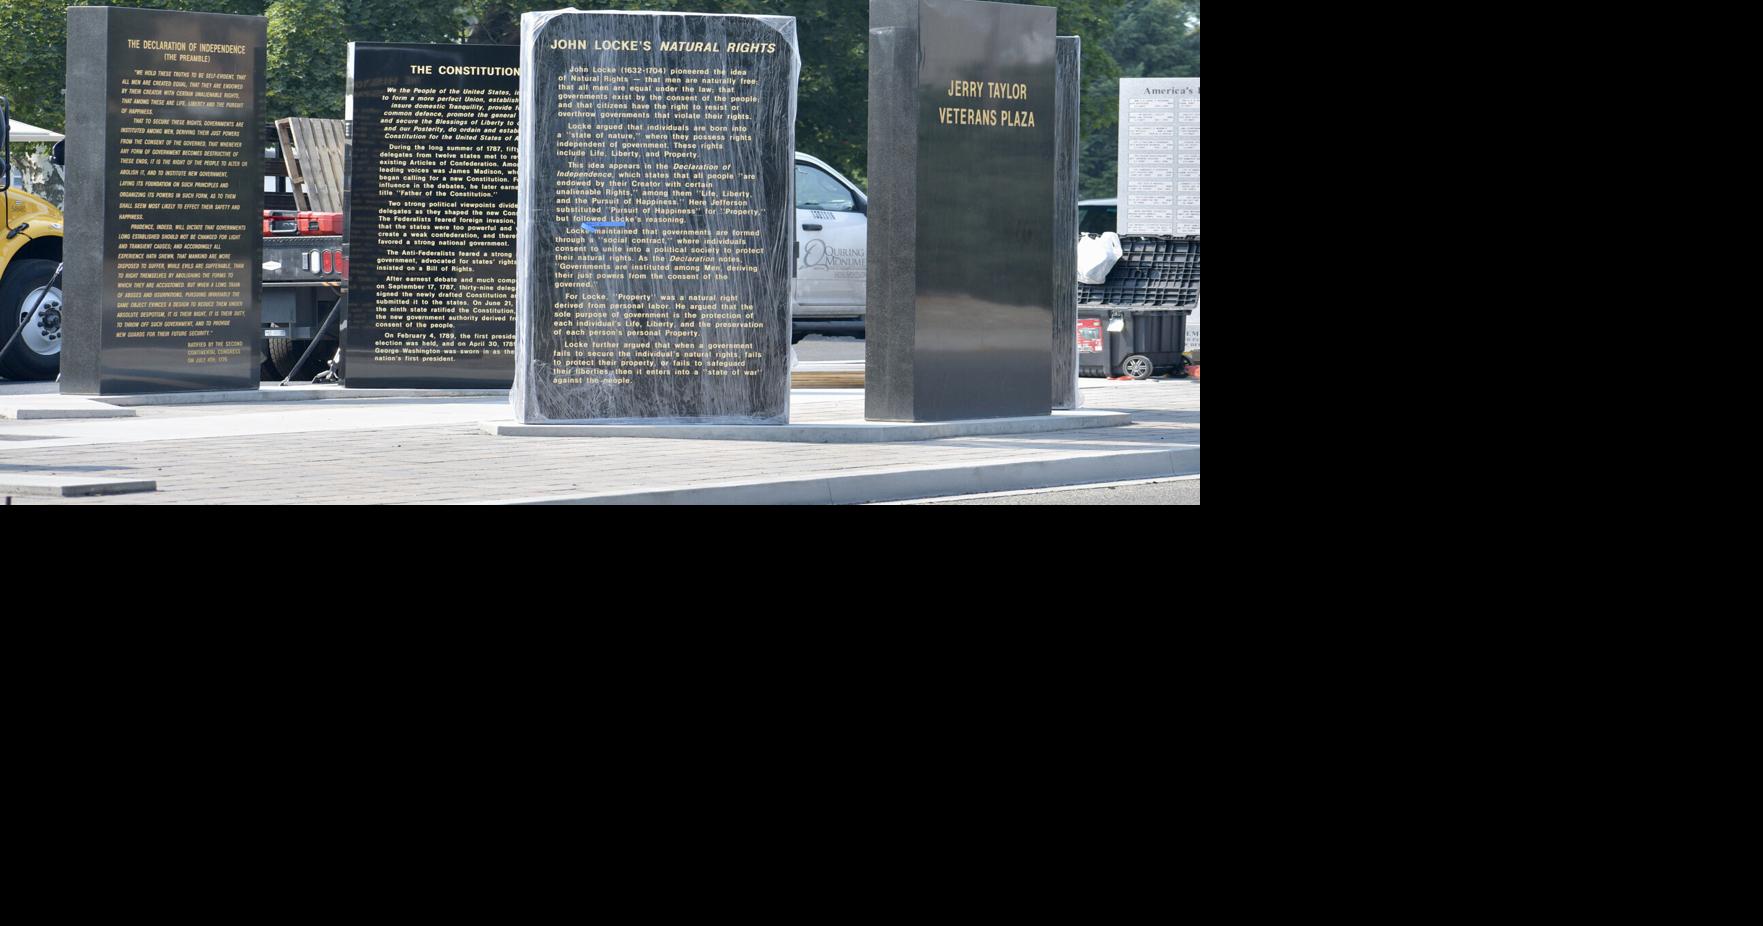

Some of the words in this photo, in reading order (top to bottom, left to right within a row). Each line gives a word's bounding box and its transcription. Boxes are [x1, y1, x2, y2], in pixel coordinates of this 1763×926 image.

[128, 39, 139, 49] THE
[143, 40, 185, 52] DECLARATION
[188, 42, 196, 52] OF
[199, 43, 245, 55] INDEPENDENCE
[551, 39, 586, 50] JOHN
[595, 40, 650, 52] LOCKE'S
[659, 41, 718, 53] NATURAL
[727, 42, 775, 54] RIGHTS
[164, 53, 176, 61] (THE
[179, 54, 210, 63] PREAMBLE)
[410, 65, 431, 74] THE
[438, 65, 519, 76] CONSTITUTION
[569, 66, 588, 74] John
[592, 66, 615, 74] Locke
[621, 67, 666, 76] (1632-1704)
[670, 68, 709, 78] pioneered
[730, 68, 746, 76] idea
[413, 87, 436, 96] People
[948, 80, 983, 97] JERRY
[988, 82, 1026, 99] TAYLOR
[558, 110, 595, 119] overthrow
[600, 111, 649, 121] governments
[654, 112, 669, 120] that
[674, 112, 700, 120] violate
[705, 112, 722, 120] their
[939, 108, 996, 126] VETERANS
[1001, 110, 1034, 127] PLAZA
[568, 122, 591, 130] Locke
[596, 123, 622, 132] argued
[647, 124, 688, 132] individuals
[710, 124, 727, 132] born
[732, 125, 746, 133] into
[389, 144, 410, 153] During
[428, 144, 442, 153] long
[556, 149, 585, 158] include
[645, 150, 659, 158] and
[379, 166, 403, 176] leading
[556, 179, 590, 187] endowed
[595, 180, 604, 189] by
[631, 180, 659, 188] Creator
[665, 180, 680, 188] with
[685, 180, 712, 189] certain
[459, 216, 482, 226] foreign
[572, 215, 606, 223] followed
[611, 215, 641, 223] Locke's
[414, 239, 435, 248] strong
[491, 250, 512, 260] strong
[576, 320, 620, 328] individual's
[715, 321, 763, 330] preservation
[397, 332, 426, 341] February
[566, 329, 584, 337] each
[589, 329, 622, 338] person's
[627, 329, 660, 339] personal
[564, 341, 587, 349] Locke
[592, 341, 618, 349] further
[624, 341, 650, 351] argued
[654, 342, 669, 350] that
[708, 342, 752, 352] government
